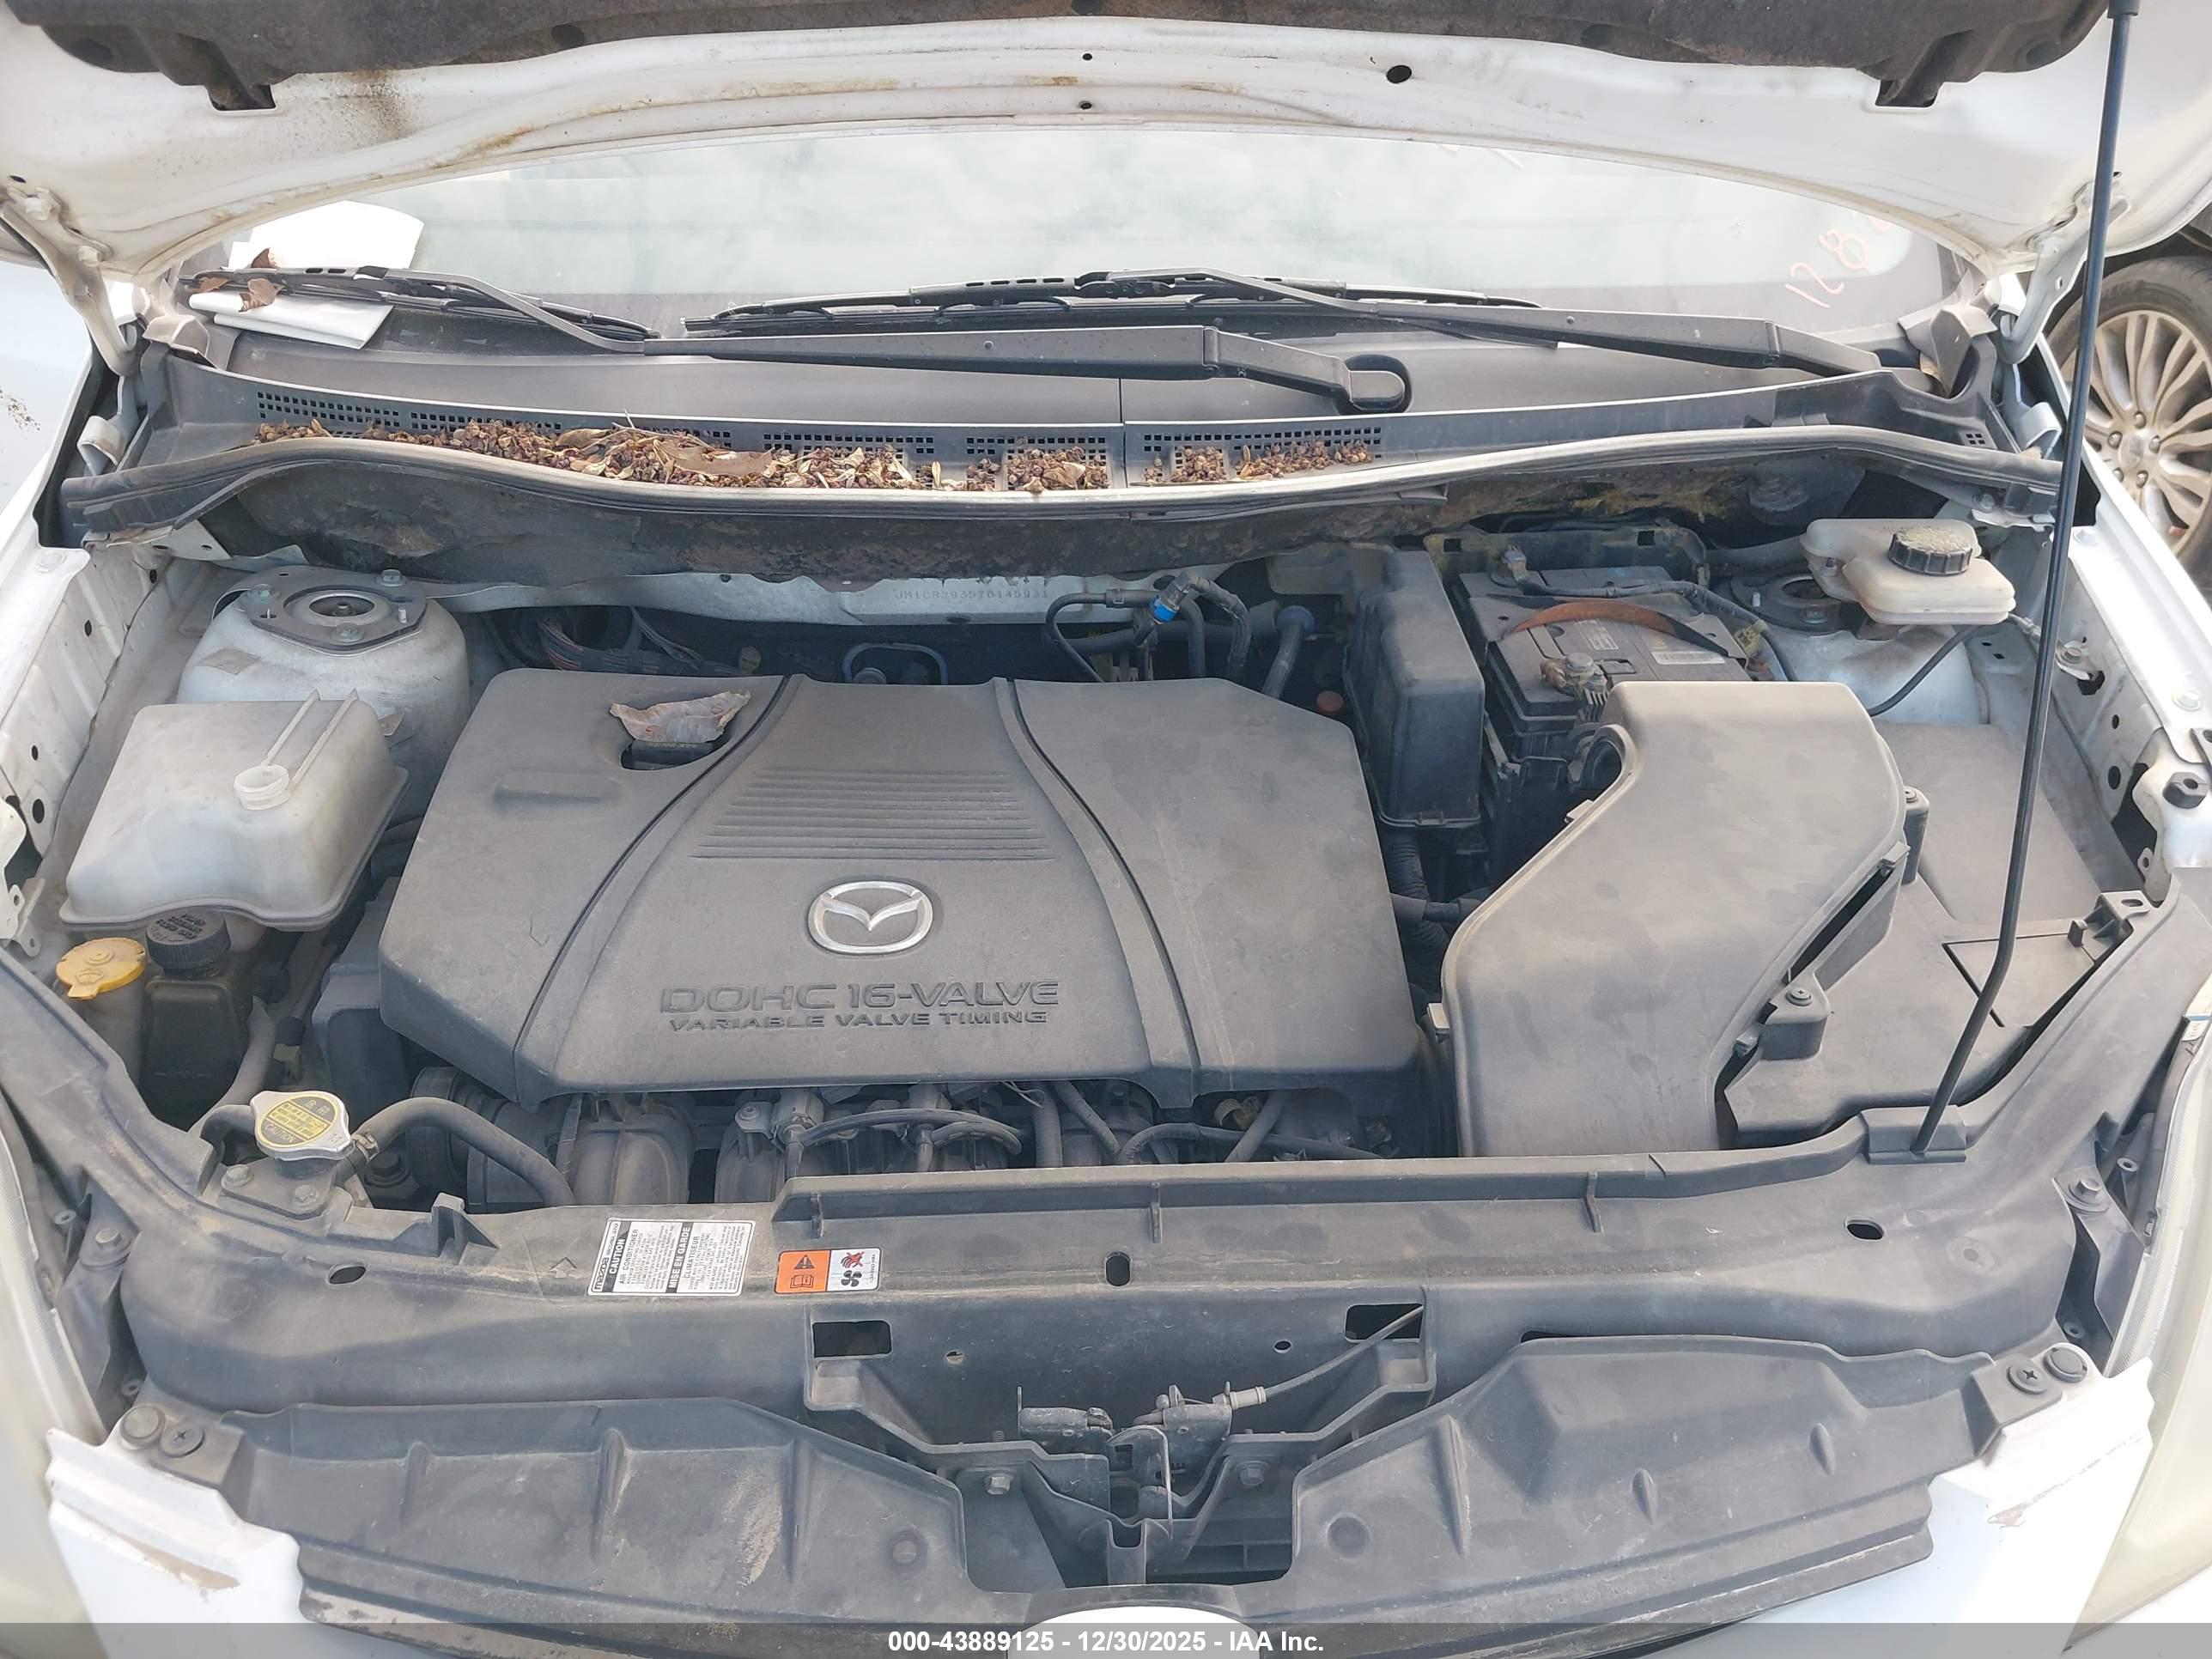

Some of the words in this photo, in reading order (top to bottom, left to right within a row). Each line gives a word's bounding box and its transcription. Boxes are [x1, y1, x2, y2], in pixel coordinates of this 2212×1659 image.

[659, 983, 837, 1013] DOHC
[848, 981, 1059, 1009] 16-VALVE
[670, 1015, 825, 1031] VARIABLE
[836, 1012, 930, 1027] VALVE
[939, 1011, 1047, 1024] TIMING
[623, 1229, 638, 1271] CONDITIONER
[677, 1226, 690, 1255] GARDE
[609, 1238, 625, 1274] CAUTION
[673, 1255, 684, 1266] EN
[684, 1236, 700, 1279] CLIMATISEUR
[668, 1268, 681, 1288] MISE
